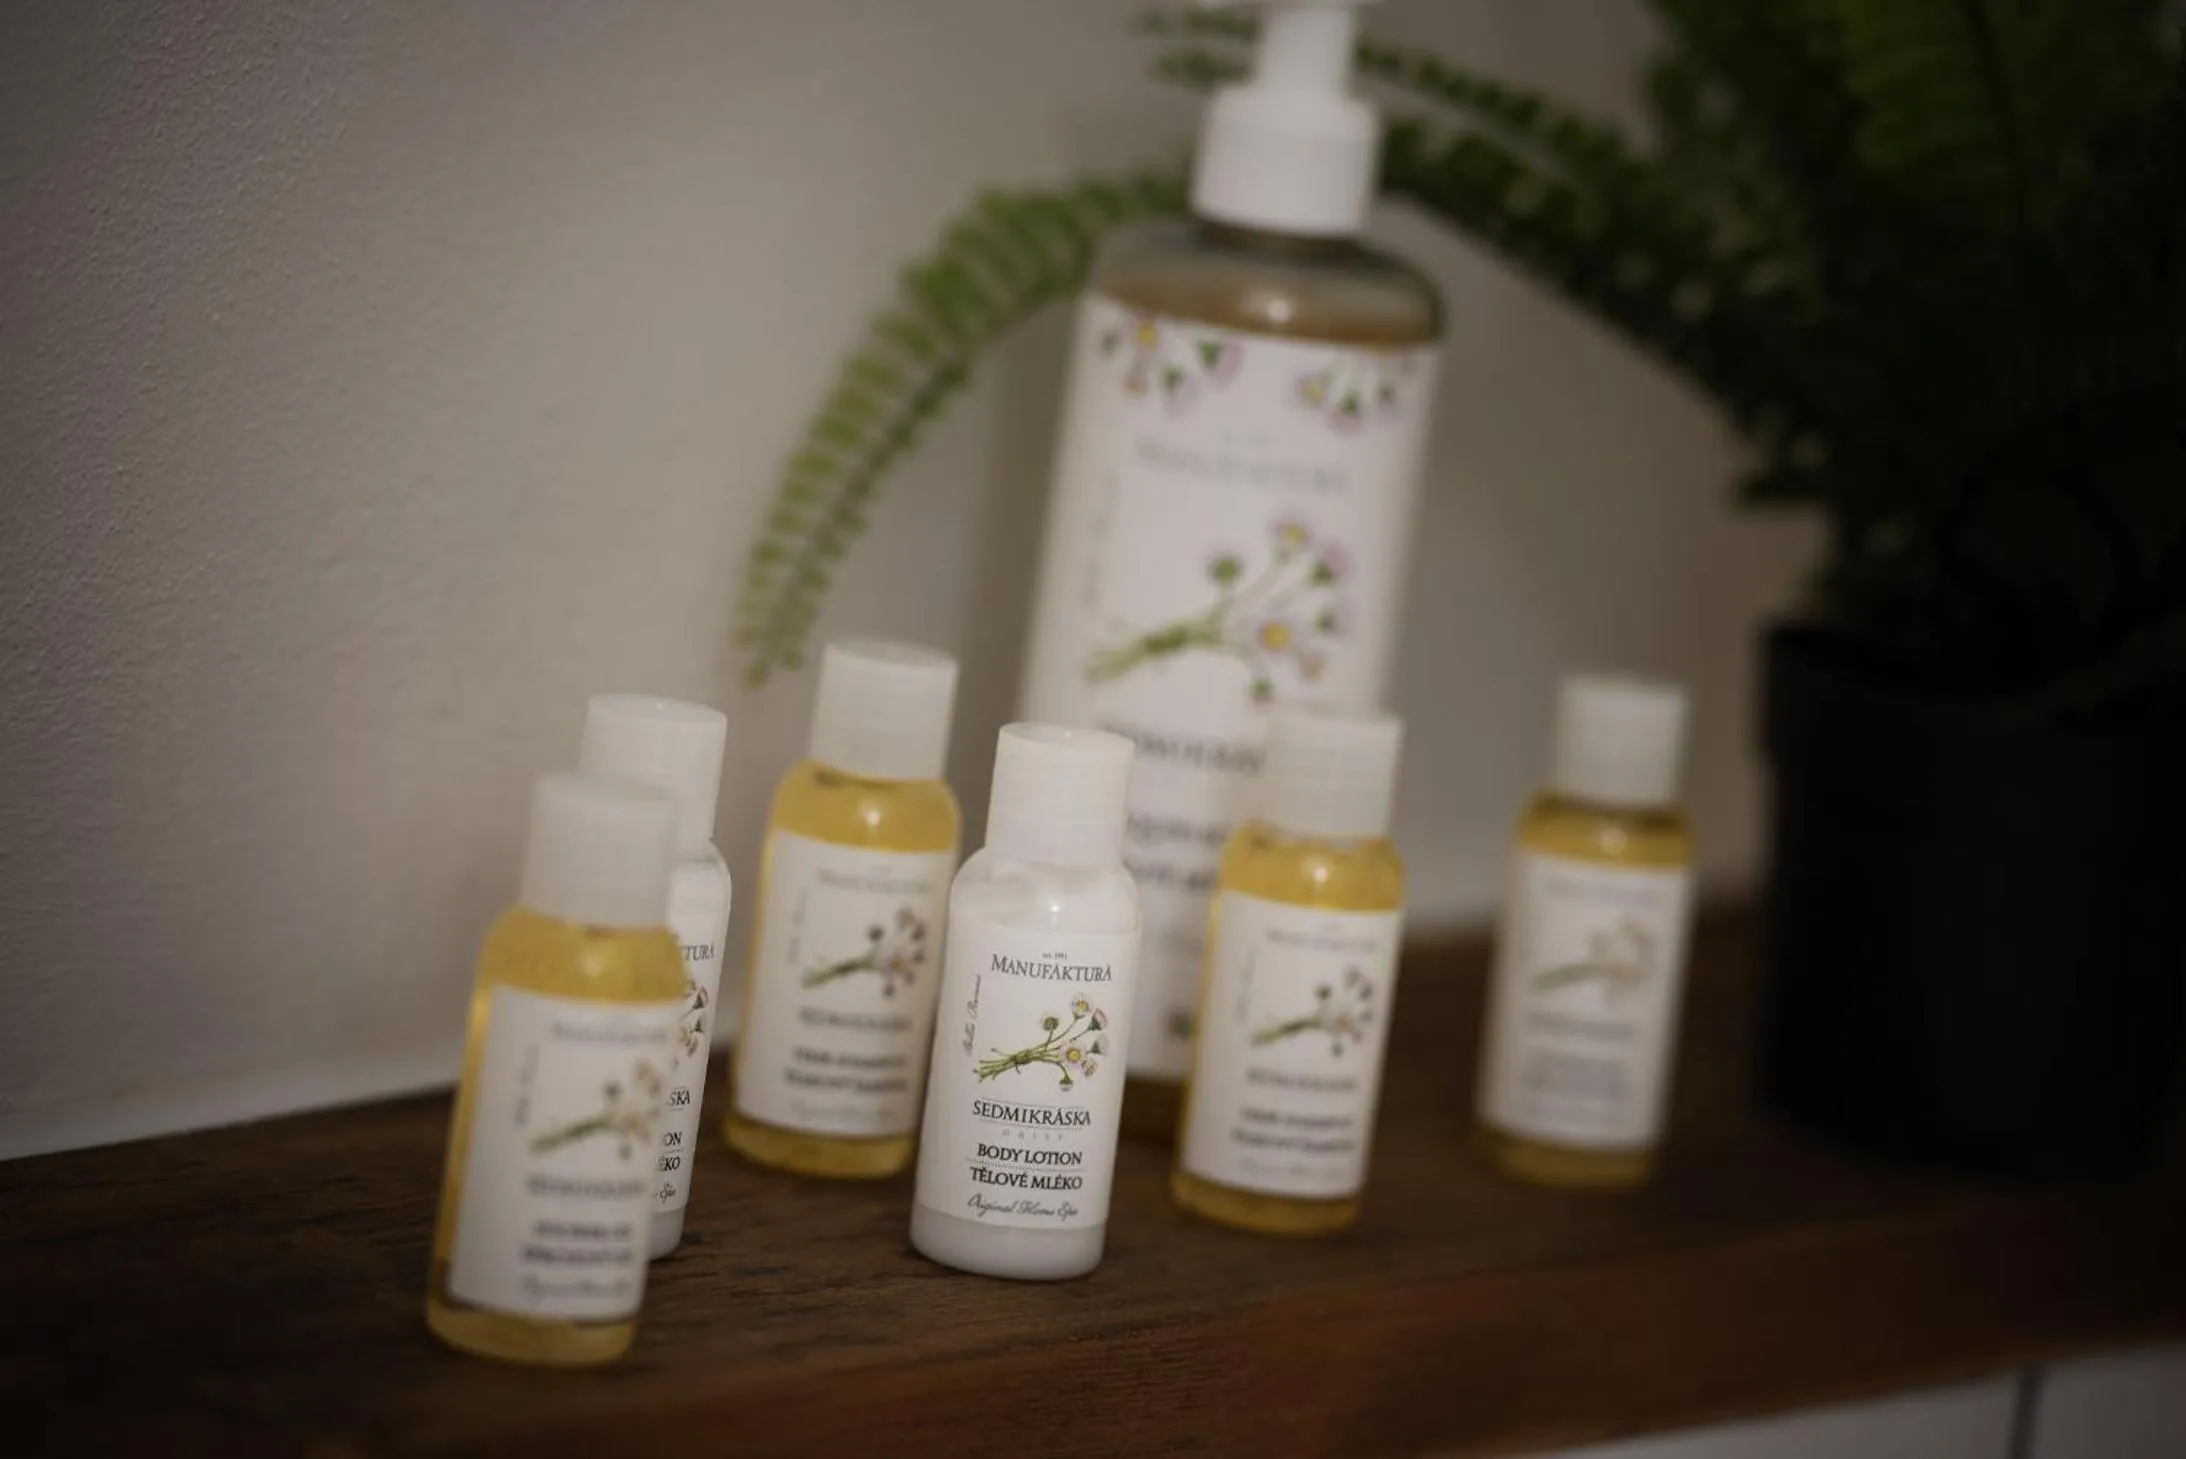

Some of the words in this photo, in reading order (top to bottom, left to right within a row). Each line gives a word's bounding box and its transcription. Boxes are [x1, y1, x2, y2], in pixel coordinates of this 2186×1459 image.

[990, 953, 1112, 982] MANUFAKTURA
[972, 1099, 1091, 1126] SEDMIKRÁSKA
[977, 1142, 1021, 1162] BODY
[1024, 1148, 1083, 1165] LOTION
[970, 1165, 1028, 1188] TĚLOVÉ
[1030, 1174, 1083, 1190] MLÉKO
